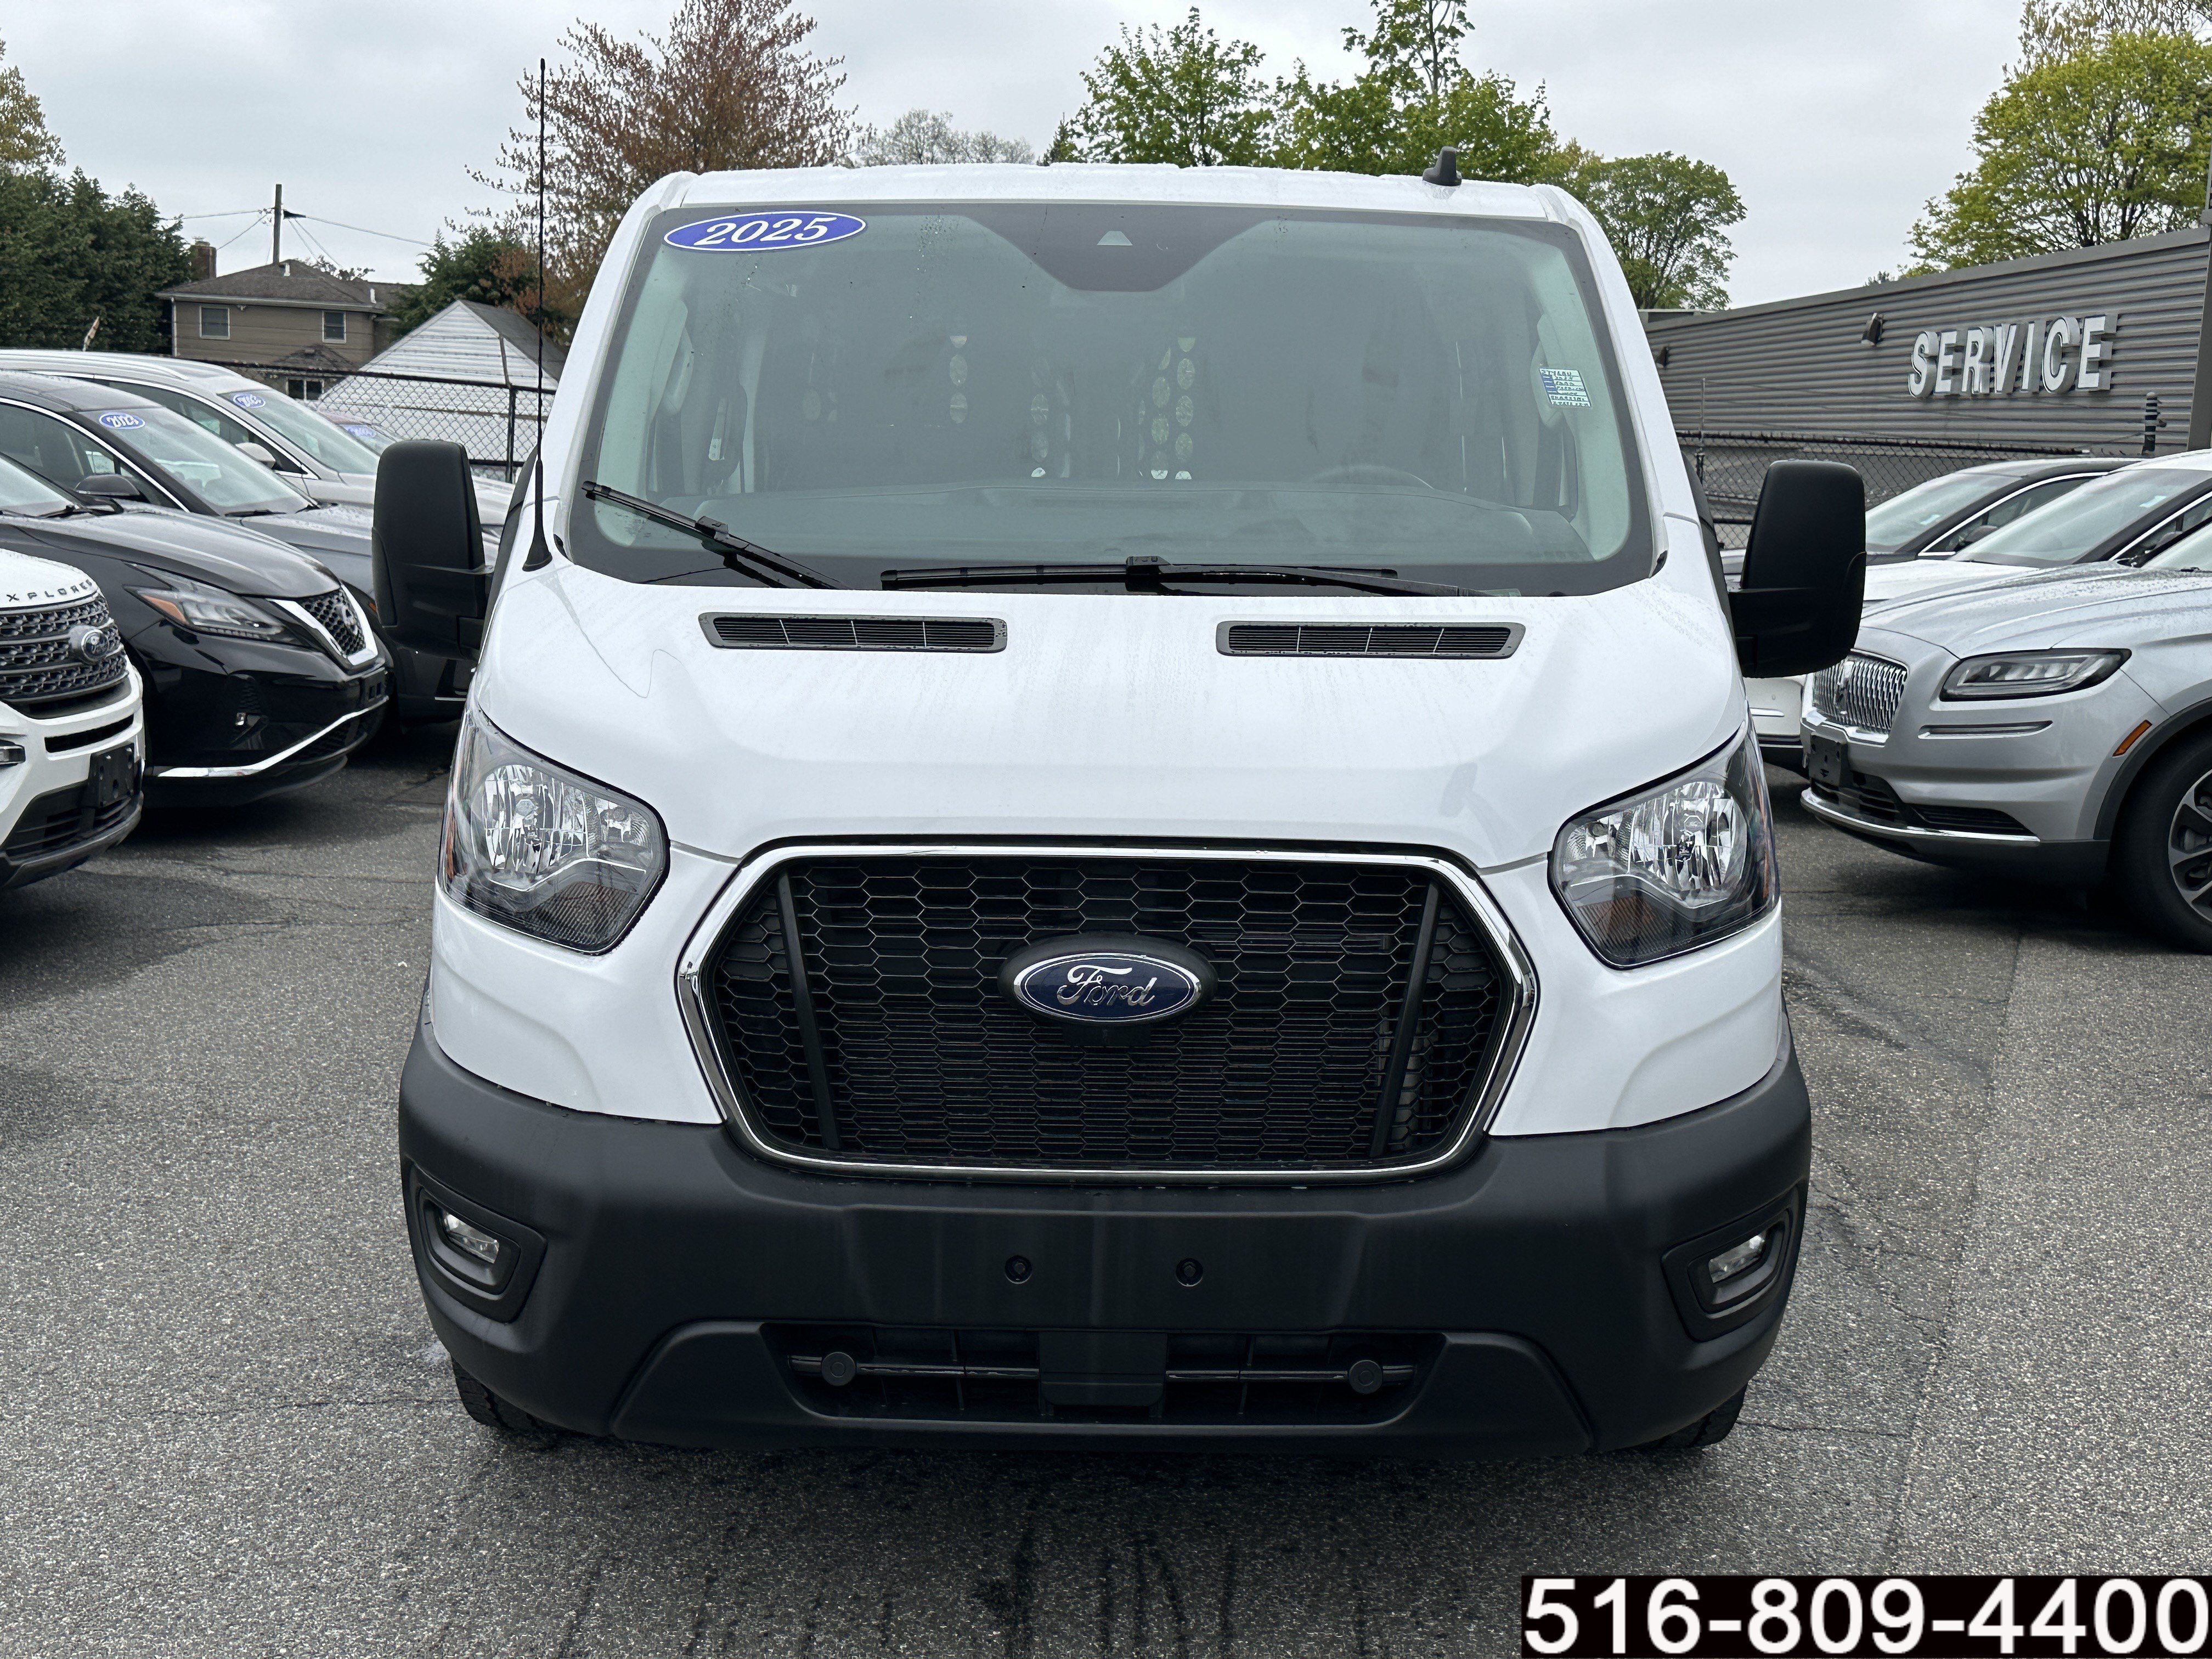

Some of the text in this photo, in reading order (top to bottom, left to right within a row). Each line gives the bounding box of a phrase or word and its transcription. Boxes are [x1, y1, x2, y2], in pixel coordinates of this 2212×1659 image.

[693, 217, 838, 246] 2025
[1908, 313, 2117, 398] SERVICE
[1056, 964, 1158, 1006] Ford
